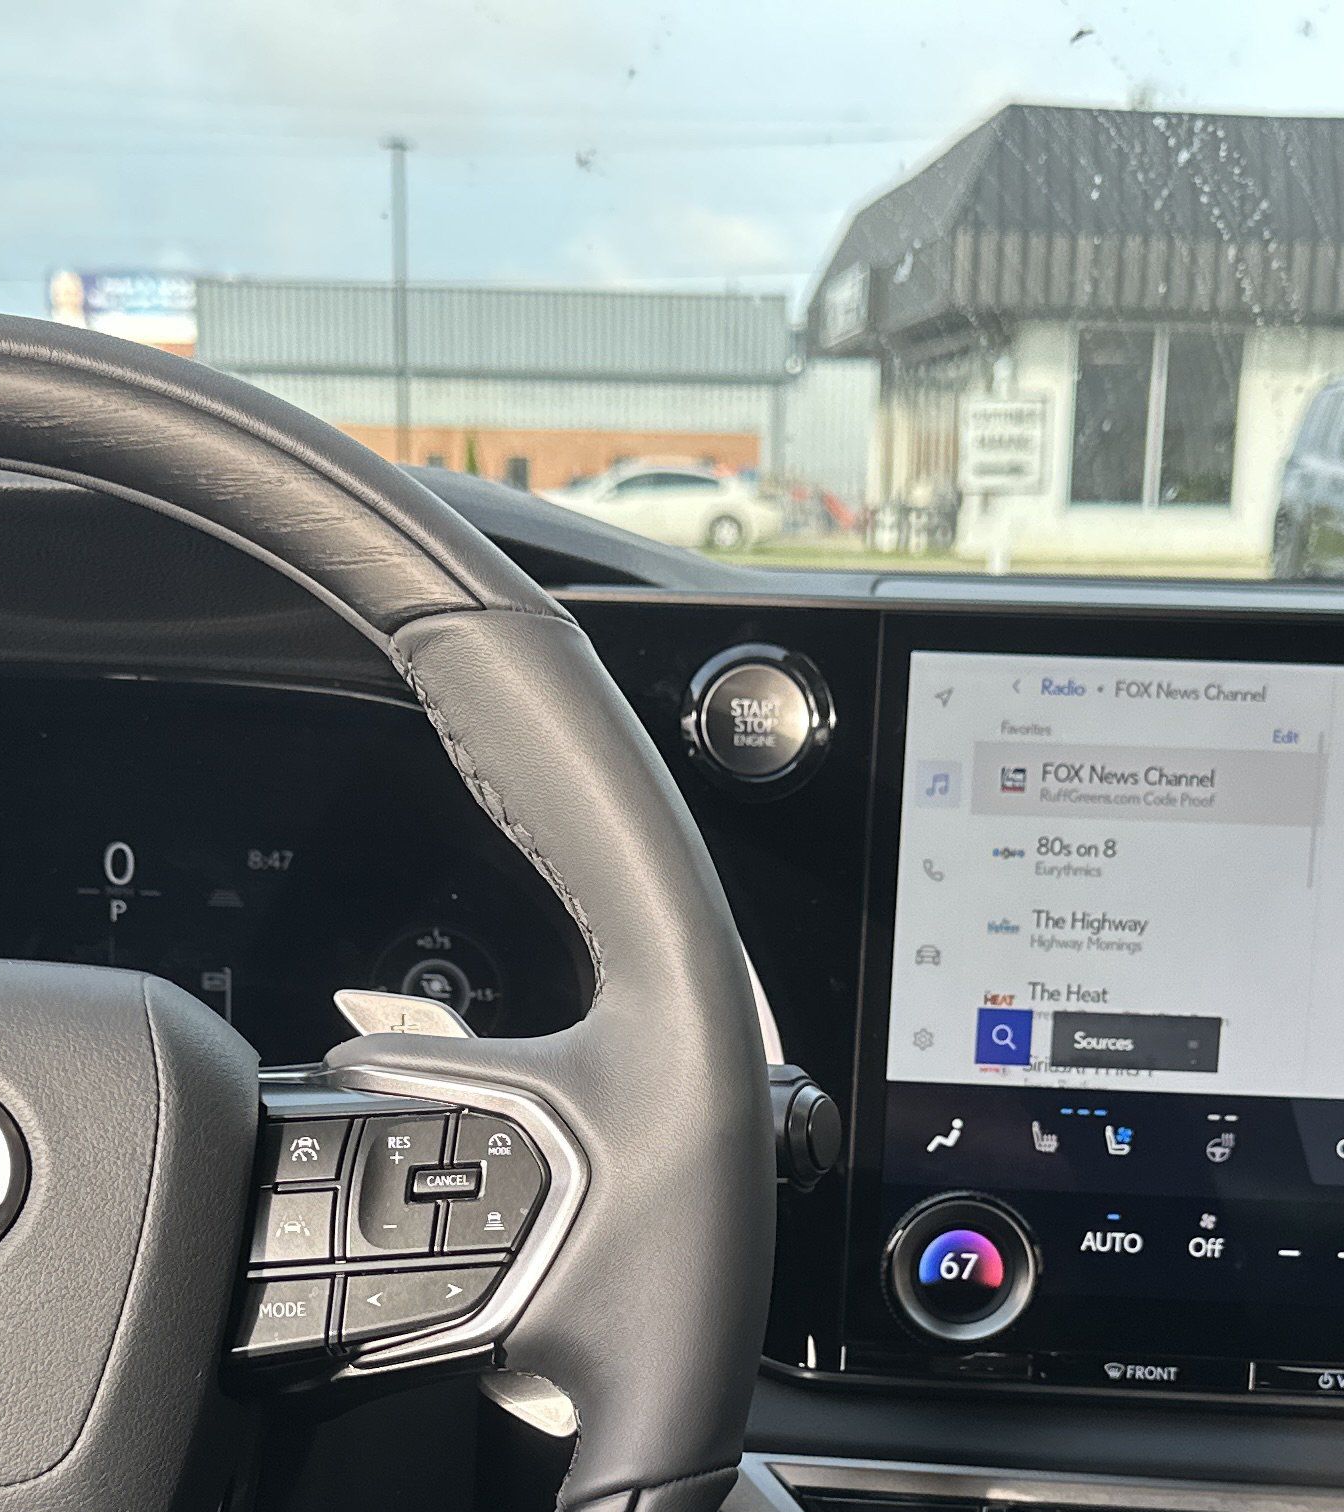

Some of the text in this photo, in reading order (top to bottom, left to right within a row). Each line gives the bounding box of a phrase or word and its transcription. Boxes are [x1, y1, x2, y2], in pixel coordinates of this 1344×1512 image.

[1040, 678, 1267, 703] Radio FOX News Channel
[730, 698, 780, 718] START
[733, 716, 778, 733] STOP
[1000, 721, 1052, 737] Favorites
[1272, 729, 1299, 745] Edit
[1042, 762, 1216, 789] FOX News Channel
[1142, 790, 1177, 807] Code
[1180, 792, 1216, 808] Proof
[1036, 836, 1072, 858] 80s
[1076, 842, 1099, 859] on
[1102, 838, 1117, 858] 8
[104, 841, 135, 886] 0
[1035, 861, 1102, 879] Eurythmics
[110, 899, 128, 922] P
[1032, 909, 1065, 930] The
[1070, 911, 1149, 935] Highway
[1030, 934, 1143, 955] Highway Mornings
[1028, 981, 1109, 1004] The Heat
[1073, 1030, 1135, 1052] Sources
[387, 1136, 411, 1150] RES
[487, 1146, 512, 1156] MODE
[426, 1174, 470, 1187] CANCEL
[1080, 1231, 1144, 1254] AUTO
[1188, 1236, 1225, 1259] Off
[939, 1253, 979, 1281] 67
[258, 1301, 307, 1319] MODE
[1126, 1363, 1179, 1382] FRONT
